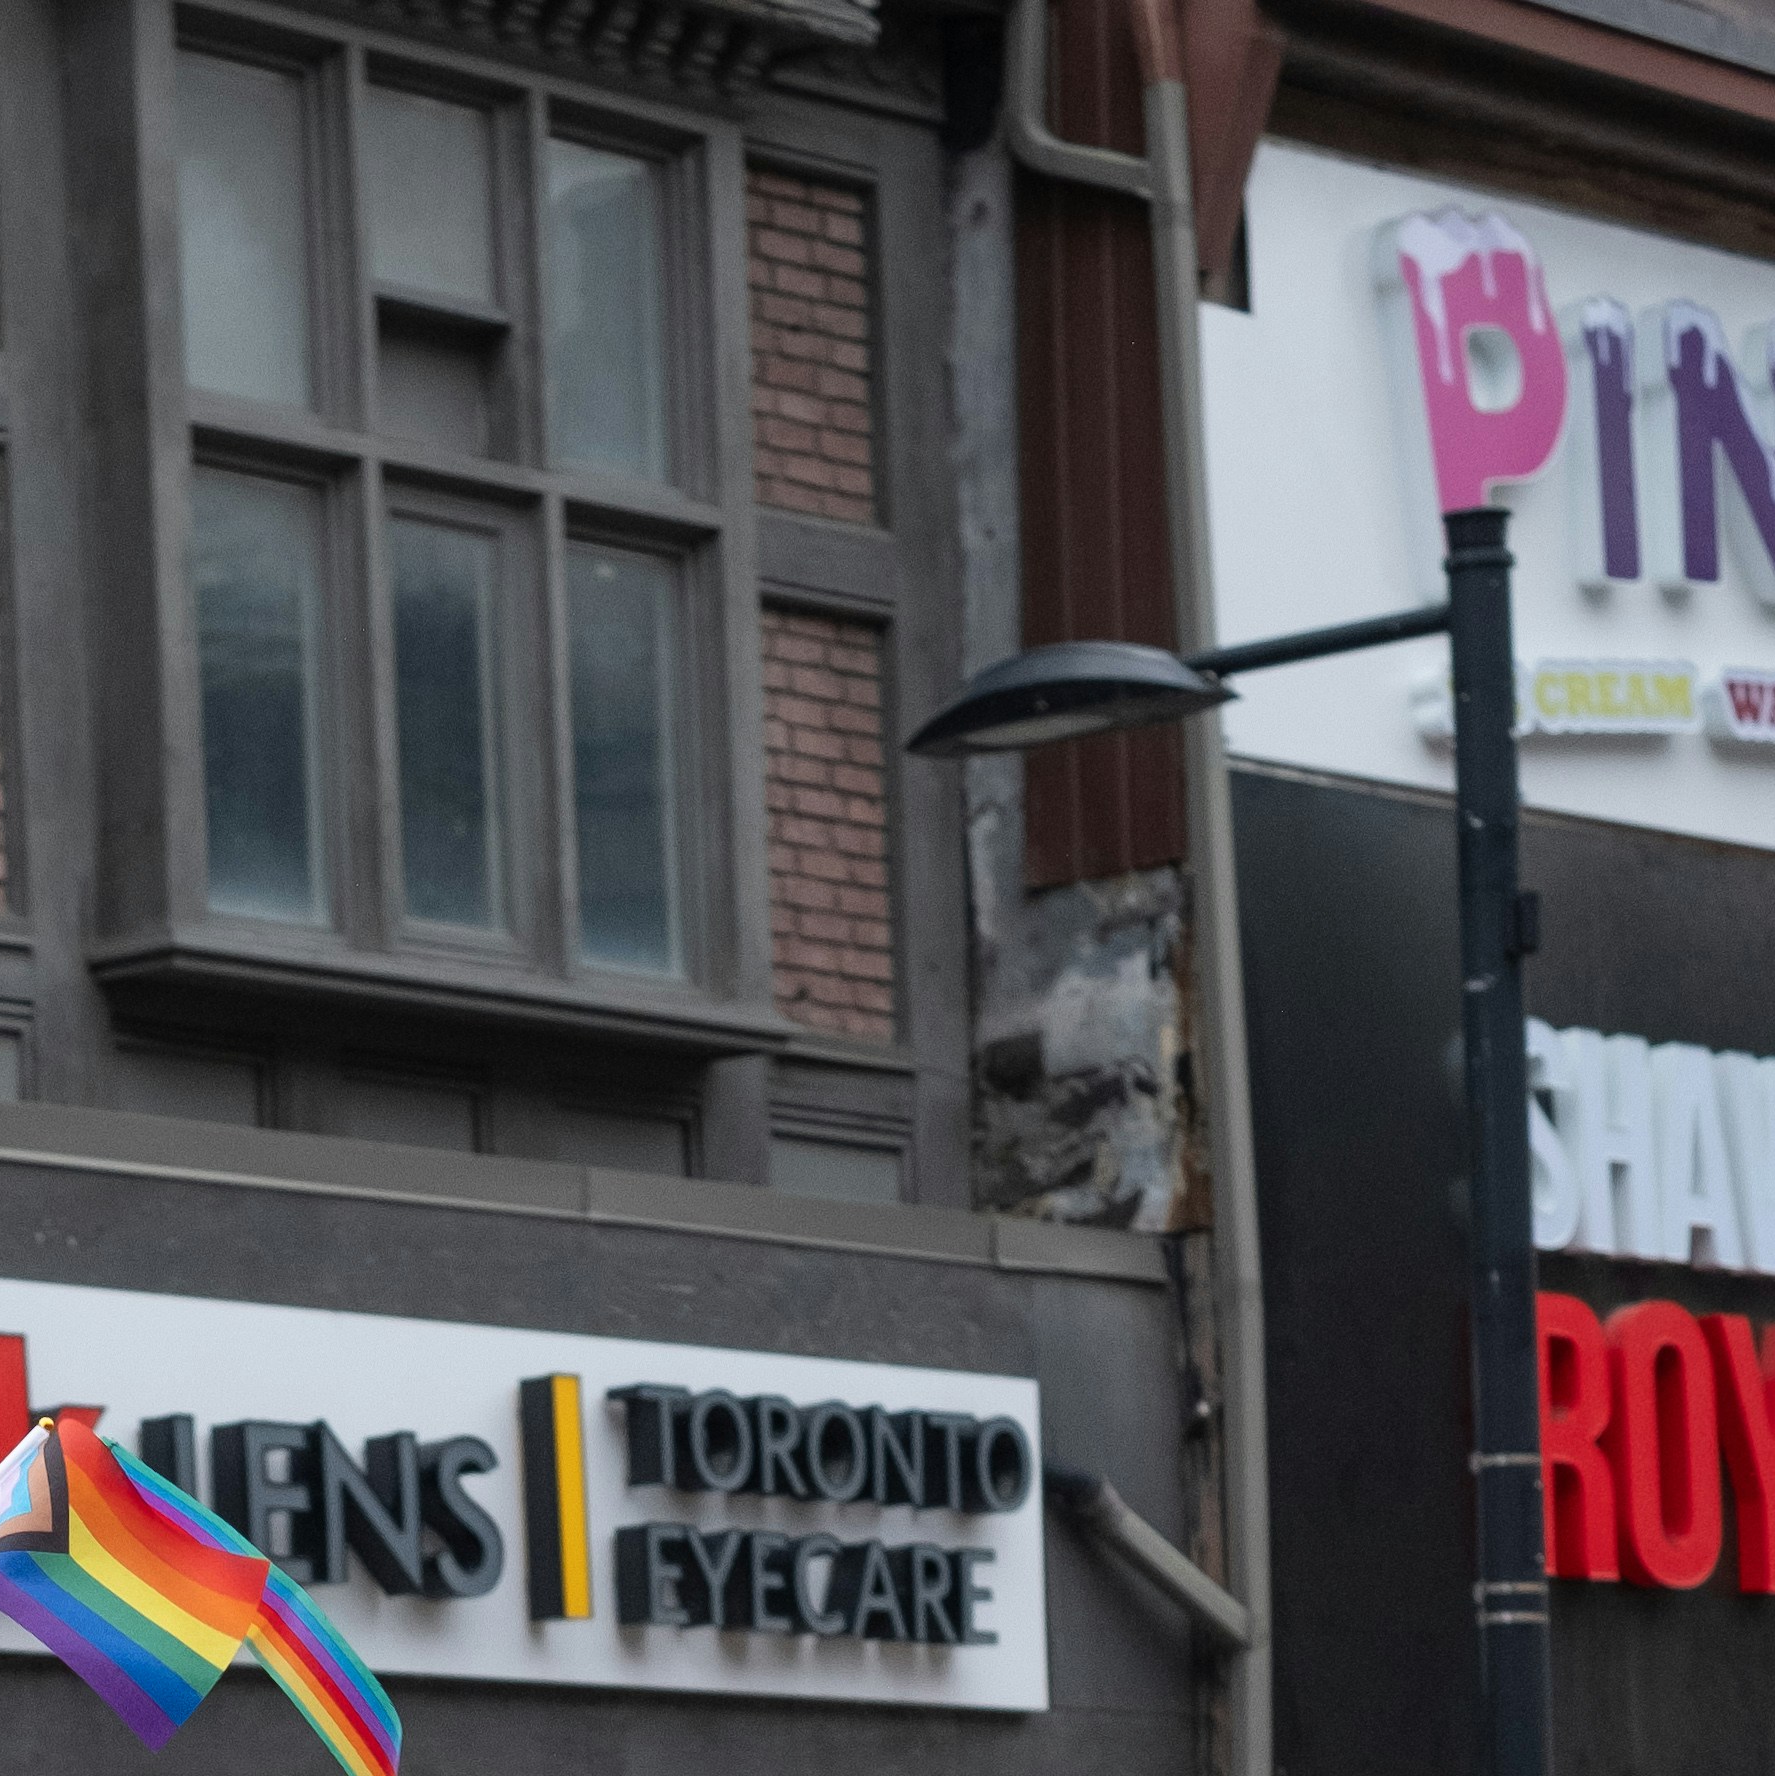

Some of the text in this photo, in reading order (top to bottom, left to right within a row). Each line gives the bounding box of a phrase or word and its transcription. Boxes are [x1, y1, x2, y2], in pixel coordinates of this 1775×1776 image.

[1534, 671, 1775, 724] CREAM W
[606, 1382, 1030, 1514] TORONTO
[615, 1522, 998, 1645] EYECARE
